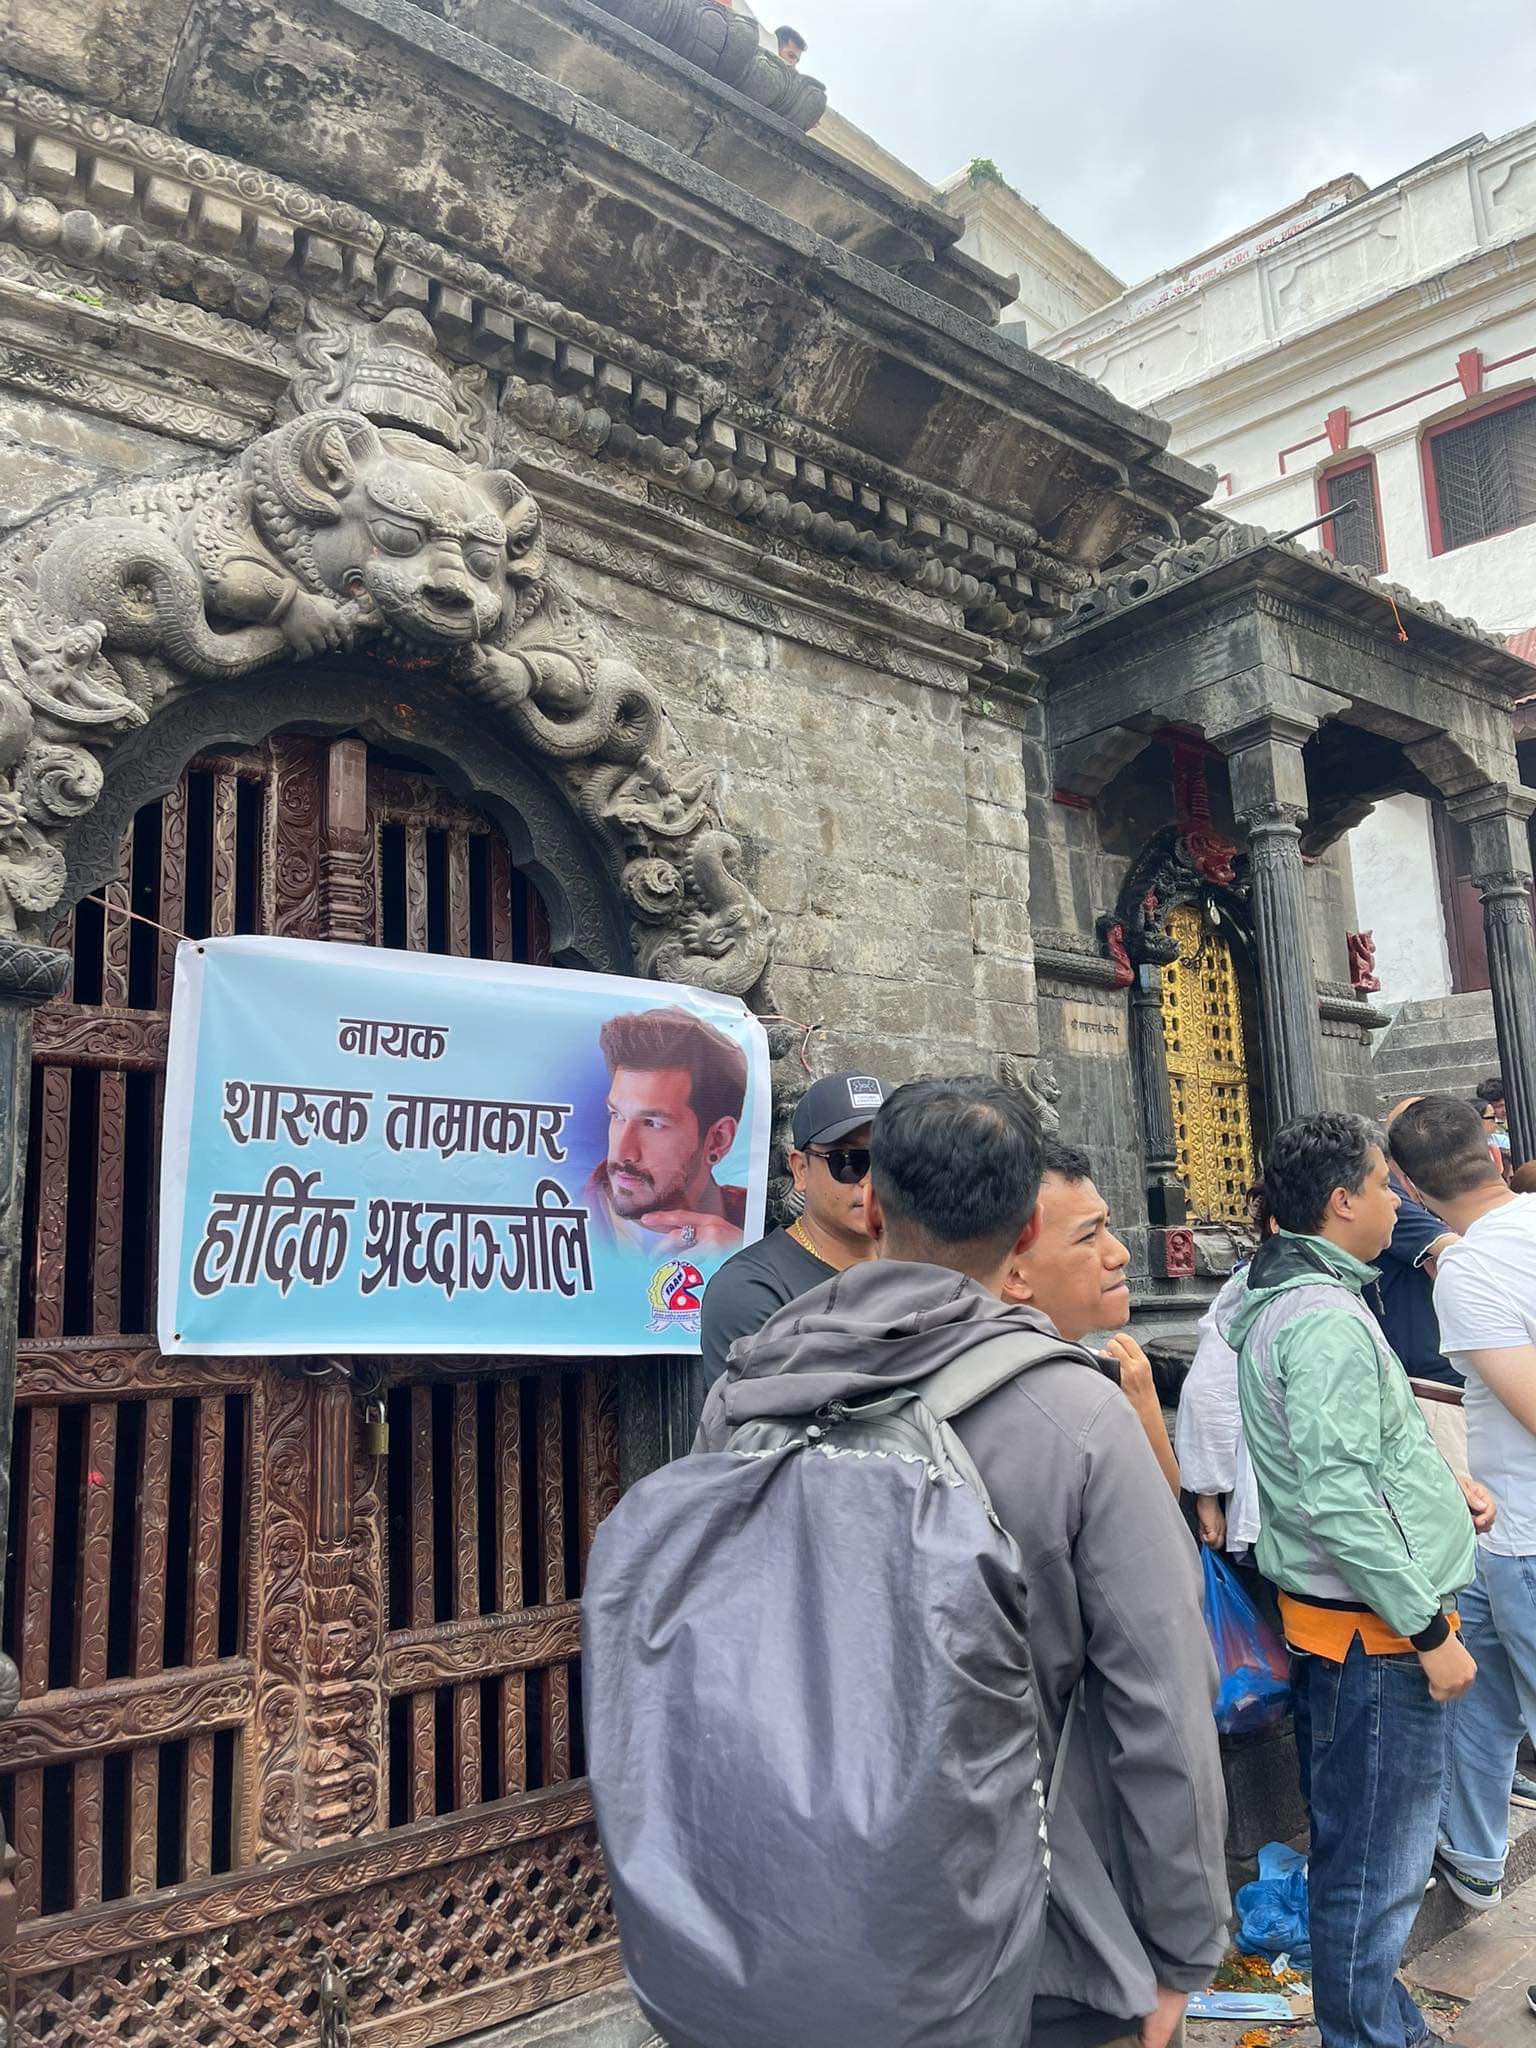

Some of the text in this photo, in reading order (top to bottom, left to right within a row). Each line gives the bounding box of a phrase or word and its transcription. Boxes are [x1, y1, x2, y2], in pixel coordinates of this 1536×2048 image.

[338, 1017, 449, 1060] नायक
[386, 1093, 571, 1161] ताम्राकार
[193, 1165, 355, 1297] हार्दिक
